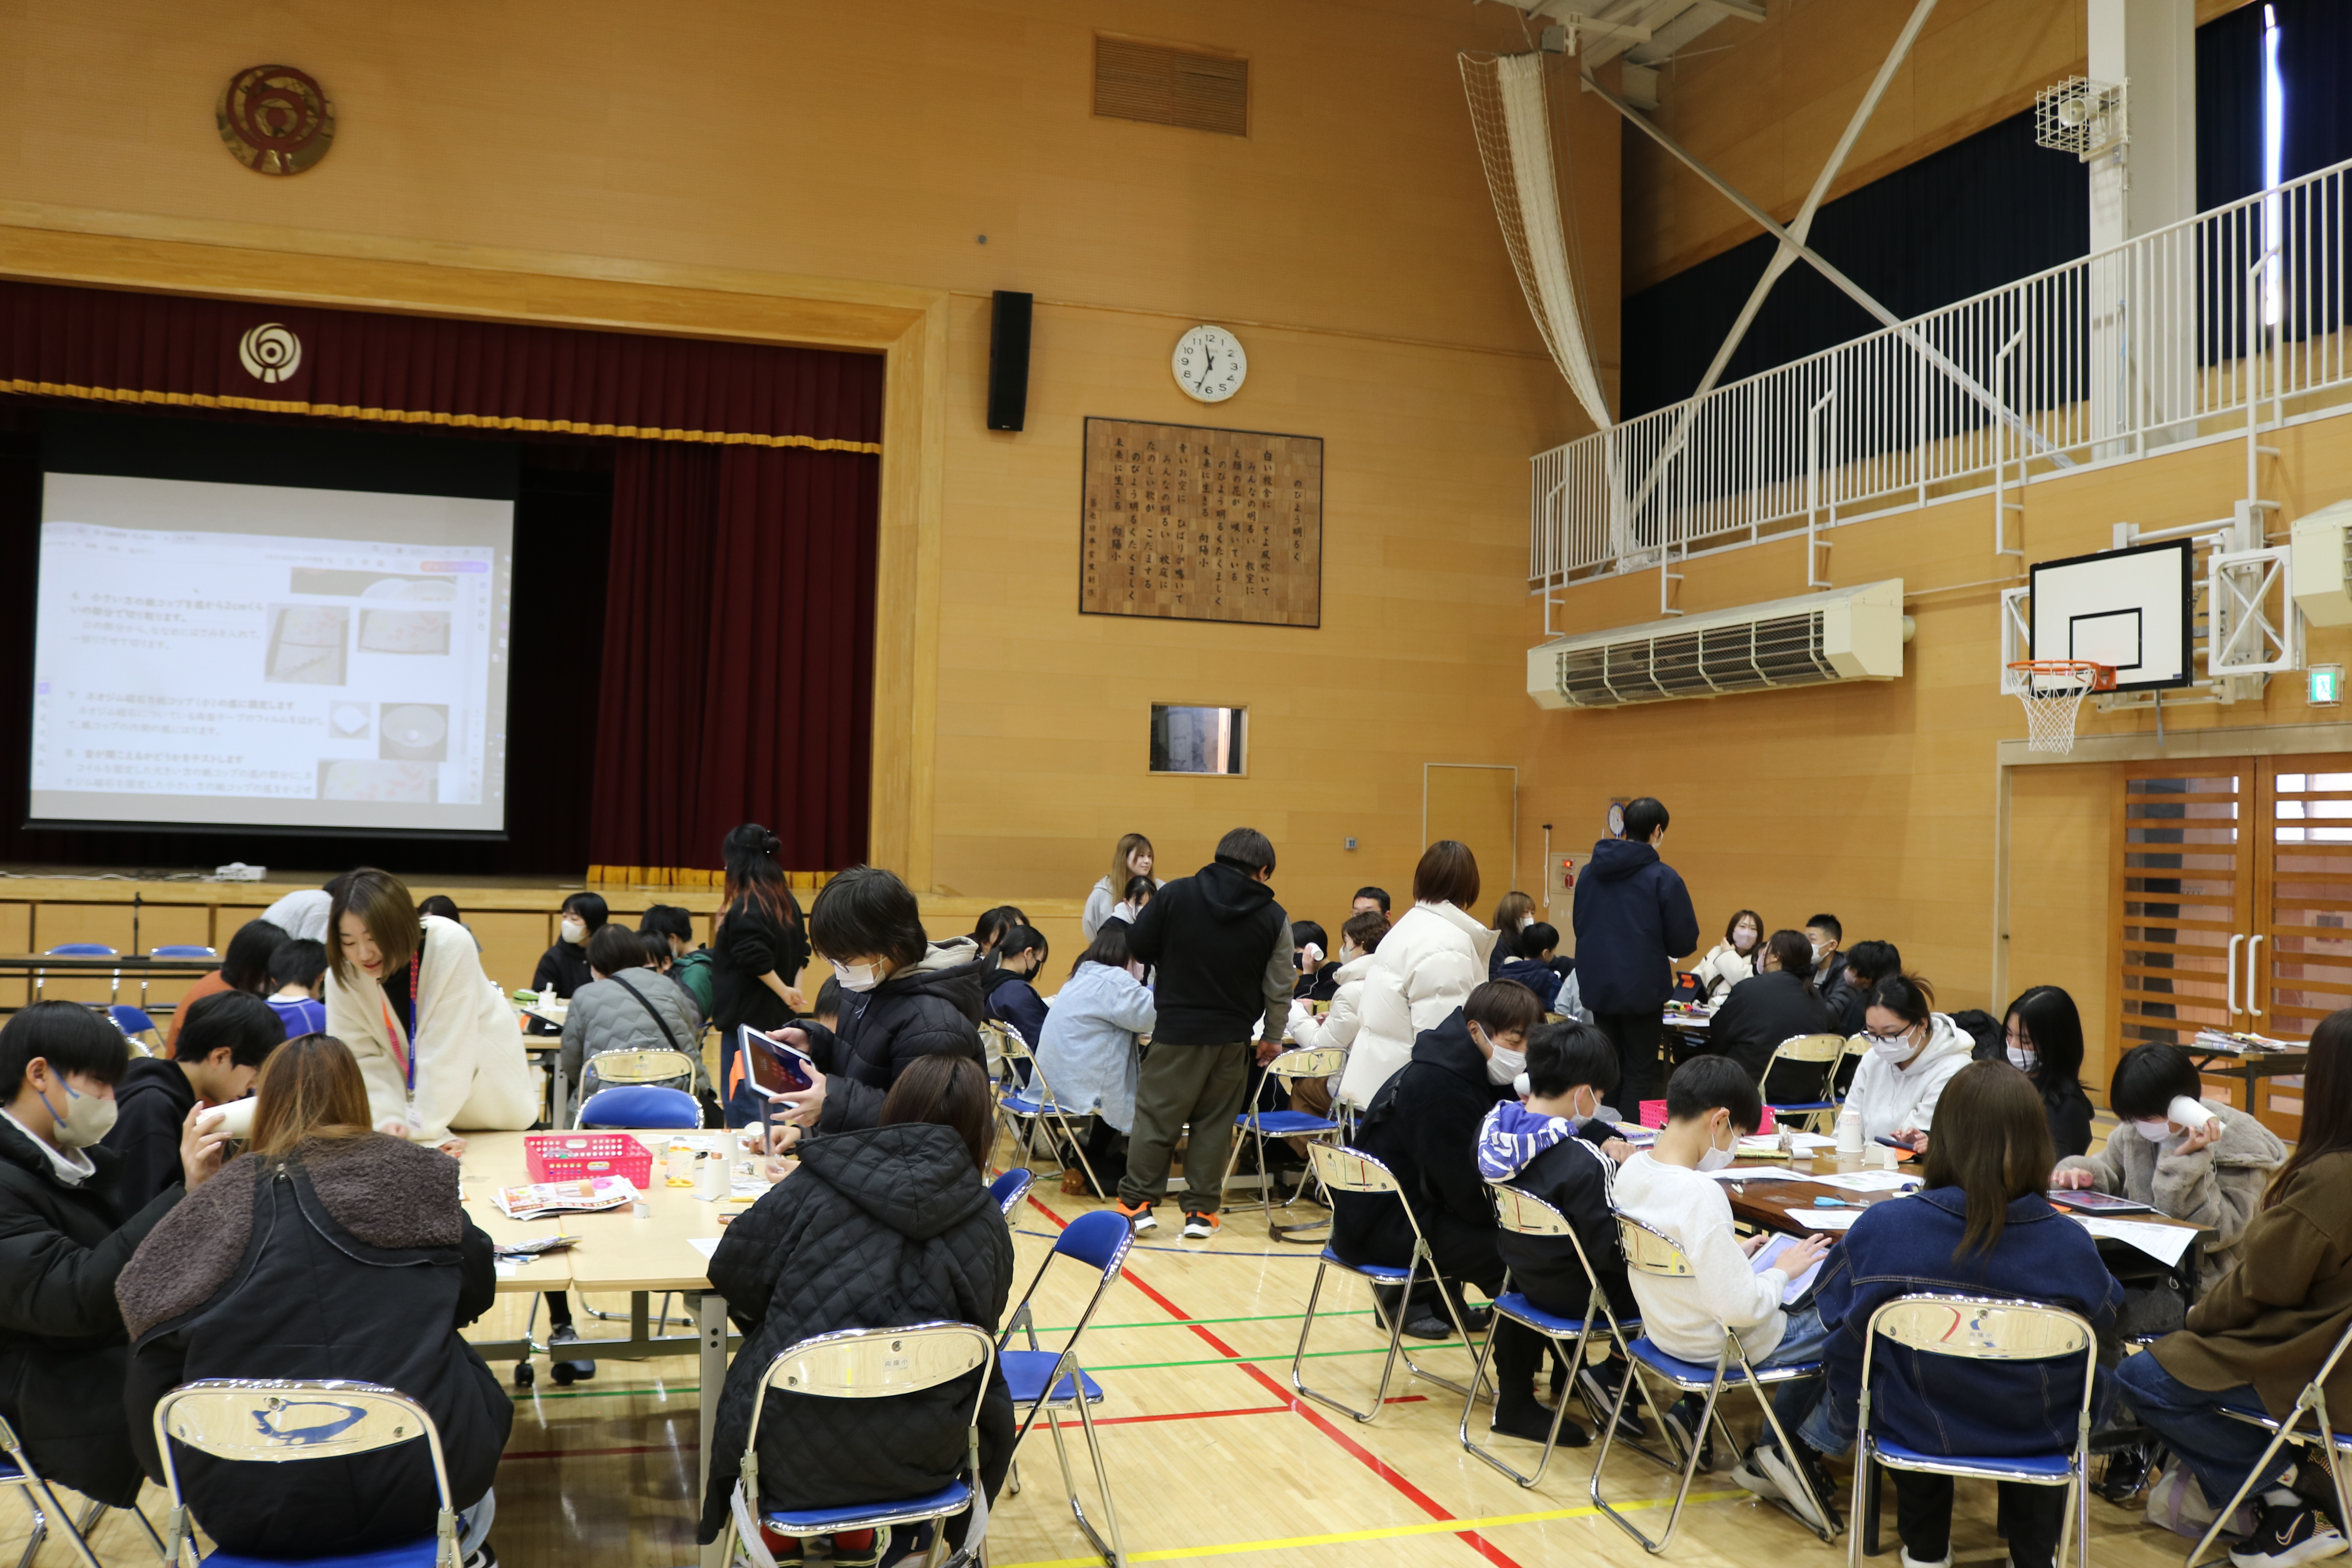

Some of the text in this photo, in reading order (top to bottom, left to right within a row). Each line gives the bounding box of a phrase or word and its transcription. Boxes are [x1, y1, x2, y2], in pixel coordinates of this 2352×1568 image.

[1111, 437, 1124, 561] 未来に生きる 向陽小
[1129, 452, 1140, 601] のびよう明るくたくましく
[1145, 441, 1156, 513] たのしい歌が
[1159, 455, 1171, 589] みんなの明るい 校庭に
[1178, 443, 1188, 503] 青いお空に
[1199, 445, 1211, 568] 未来に生きる 向陽小
[1245, 462, 1256, 595] みんなの明るい 教室に
[1261, 450, 1272, 596] 白い校舎に そよ風吹いて
[1292, 479, 1303, 562] のびよう明るく
[1230, 523, 1240, 581] 咲いている
